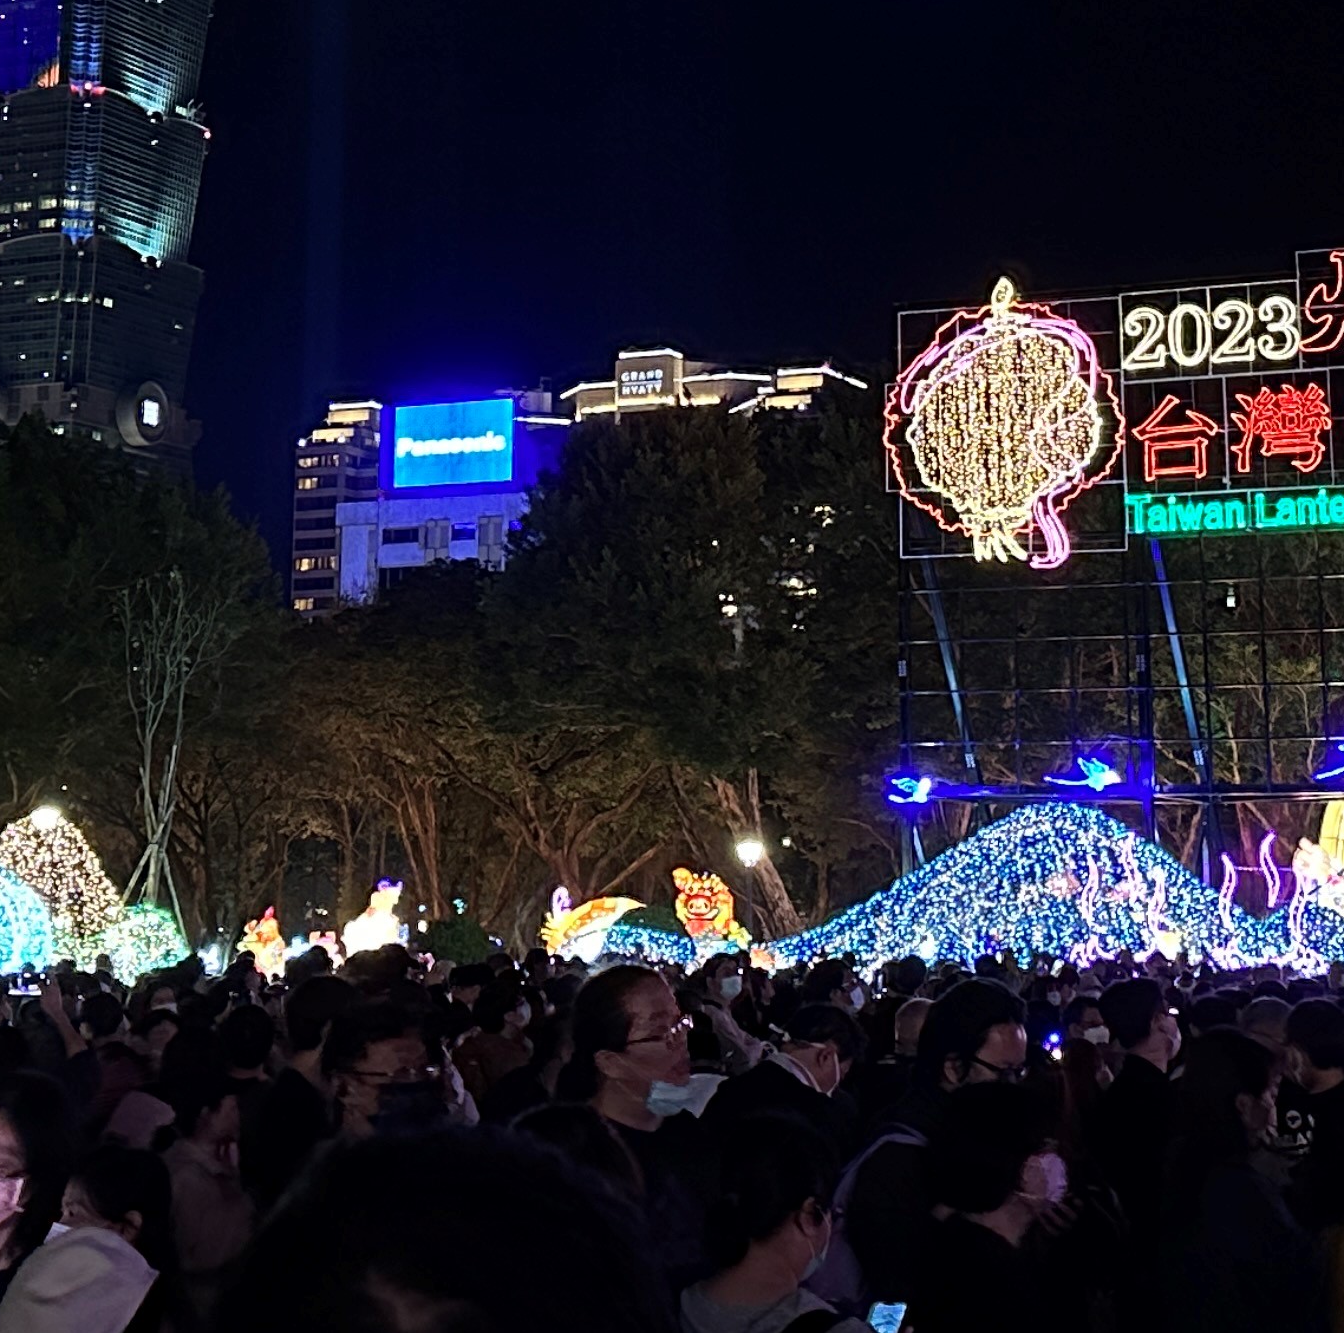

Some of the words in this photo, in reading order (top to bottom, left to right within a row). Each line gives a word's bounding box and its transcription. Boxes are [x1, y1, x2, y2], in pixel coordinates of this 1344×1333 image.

[1122, 295, 1301, 370] 2023
[620, 369, 664, 382] GRAND
[621, 383, 662, 395] HYATT
[1131, 382, 1332, 482] 台灣
[1125, 494, 1247, 534] Taiwan
